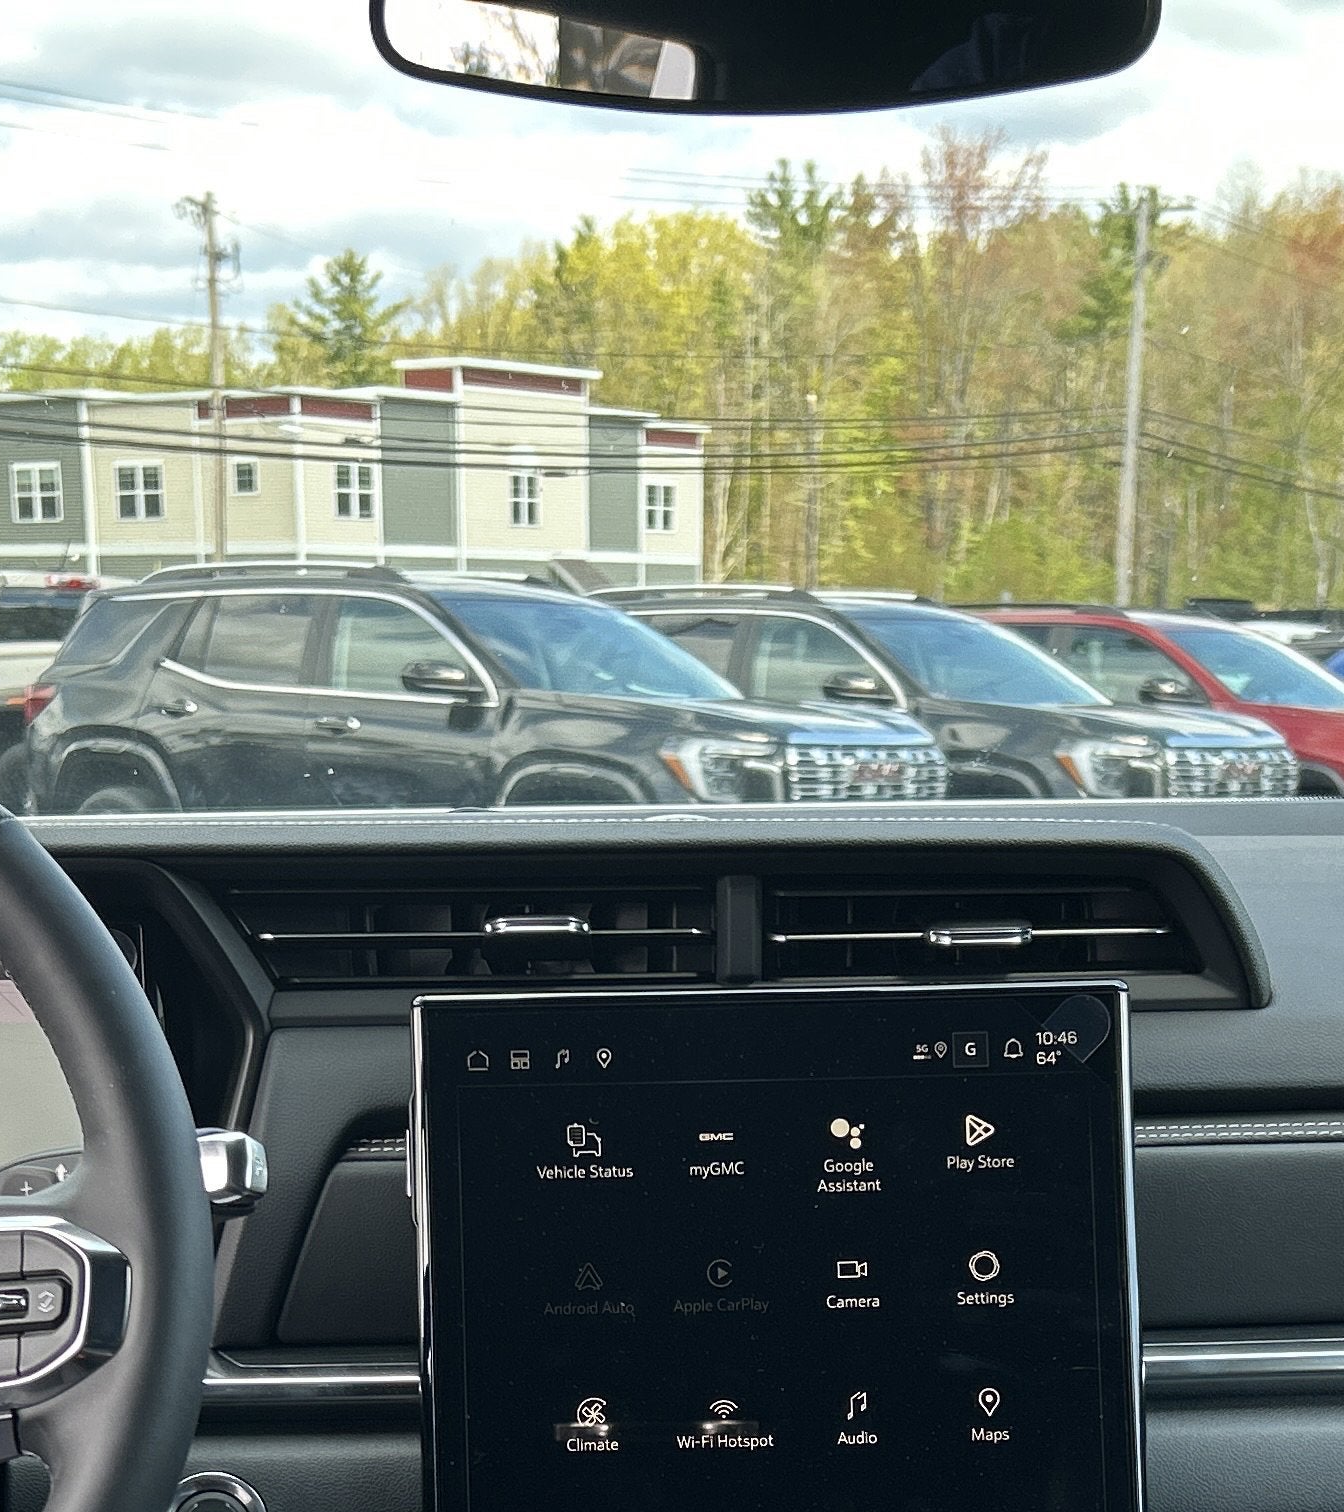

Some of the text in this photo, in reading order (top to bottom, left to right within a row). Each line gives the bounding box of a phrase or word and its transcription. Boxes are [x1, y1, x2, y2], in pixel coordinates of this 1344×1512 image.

[1035, 1031, 1078, 1046] 10:46
[916, 1045, 928, 1053] 5G
[965, 1043, 976, 1056] G
[1036, 1050, 1061, 1065] 64°
[698, 1132, 734, 1142] GMC
[689, 1161, 745, 1180] myGMC
[823, 1157, 874, 1176] Google
[946, 1154, 1015, 1173] Play Store
[536, 1164, 634, 1180] Vehicle Status
[817, 1178, 882, 1193] Assistant
[673, 1297, 770, 1316] Apple CarPlay
[826, 1294, 880, 1309] Camera
[957, 1291, 1015, 1308] Settings
[543, 1300, 635, 1316] Android Auto
[676, 1434, 774, 1451] Wi-Fi Hotspot
[837, 1430, 878, 1445] Audio
[971, 1427, 1010, 1444] Maps
[566, 1437, 619, 1452] Climate
